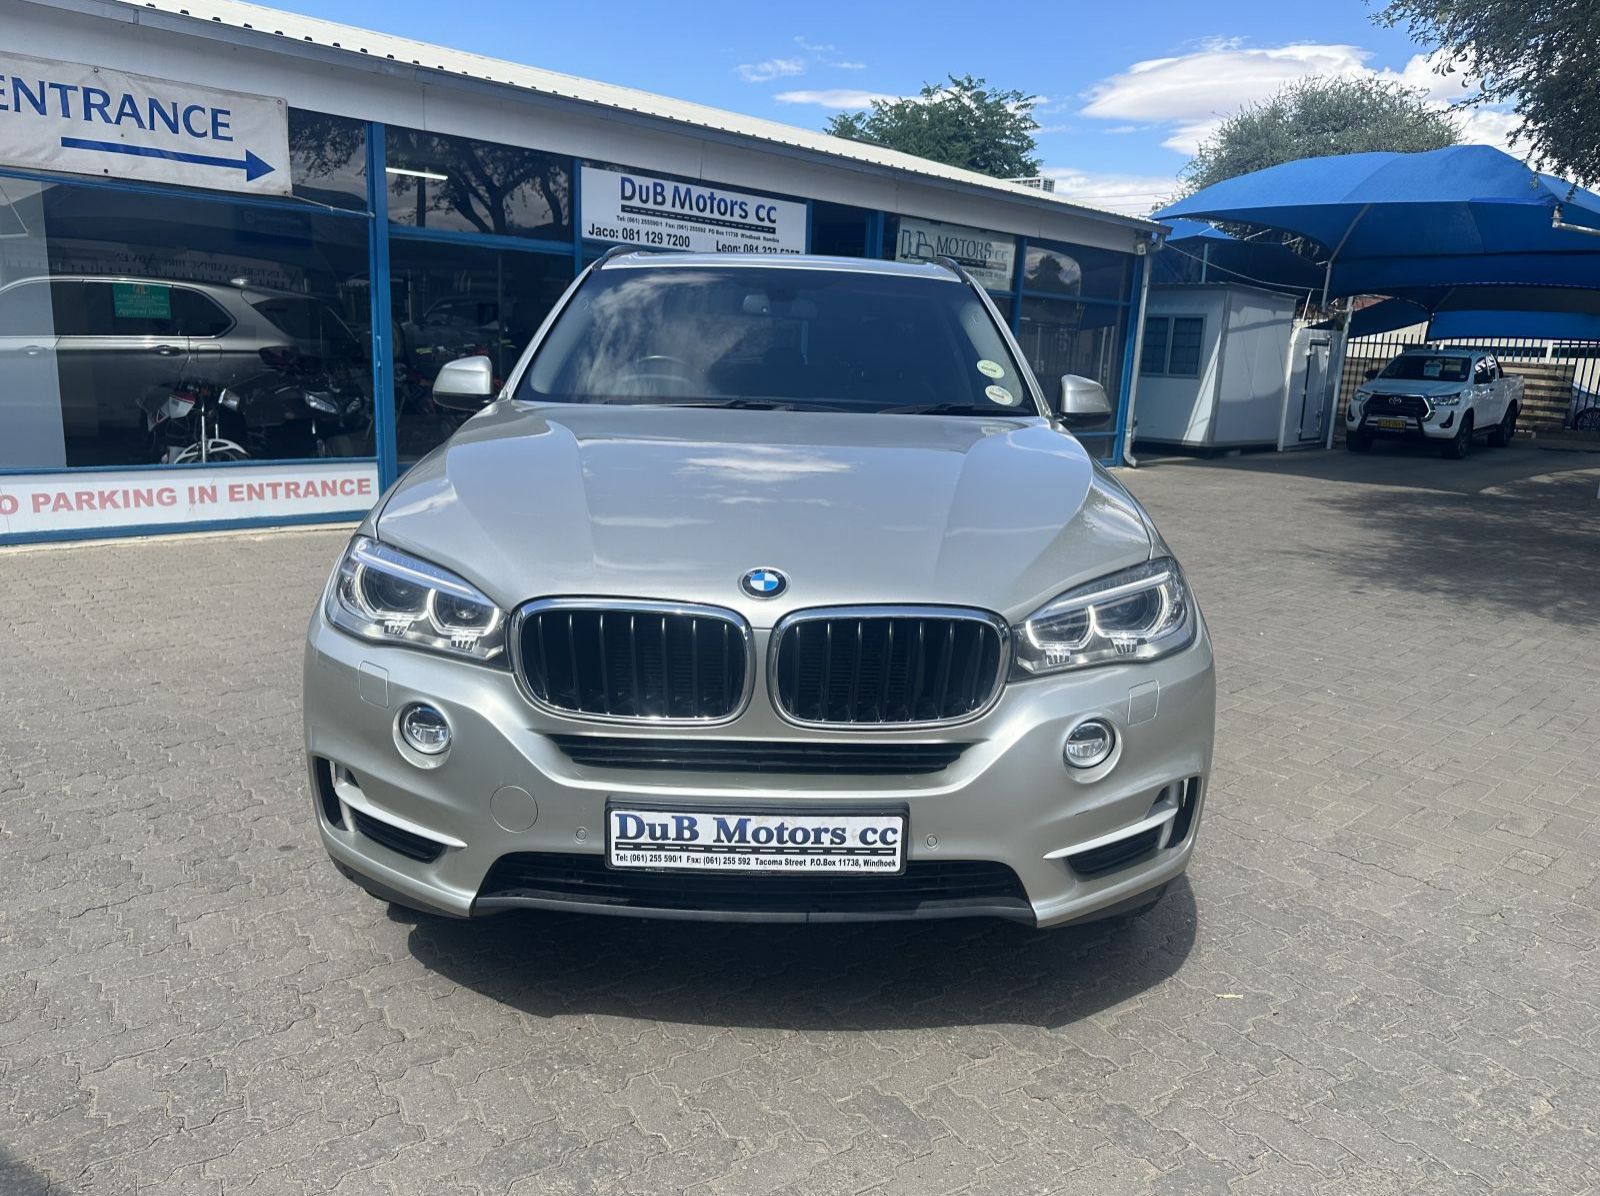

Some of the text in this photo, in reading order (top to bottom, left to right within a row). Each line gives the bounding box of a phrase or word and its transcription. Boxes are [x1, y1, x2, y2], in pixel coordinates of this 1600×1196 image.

[620, 176, 777, 224] DuB Motors cc
[588, 223, 690, 248] Jaco: 081 129 7200
[936, 235, 992, 259] MOTORS
[32, 486, 177, 514] PARKING
[188, 485, 217, 505] IN
[229, 478, 371, 502] ENTRANCE
[615, 813, 898, 846] DuB Motors cc
[615, 853, 628, 862] Tel:
[630, 854, 648, 864] (061)
[649, 854, 662, 863] 255
[686, 856, 701, 864] Fax:
[703, 856, 721, 866] (061)
[723, 856, 736, 865] 255
[737, 857, 751, 865] 592
[755, 857, 783, 866] Tacoma
[784, 857, 807, 867] Street
[810, 858, 836, 866] P.O.Box
[838, 858, 861, 868] 11738,
[863, 858, 896, 868] Windhoek
